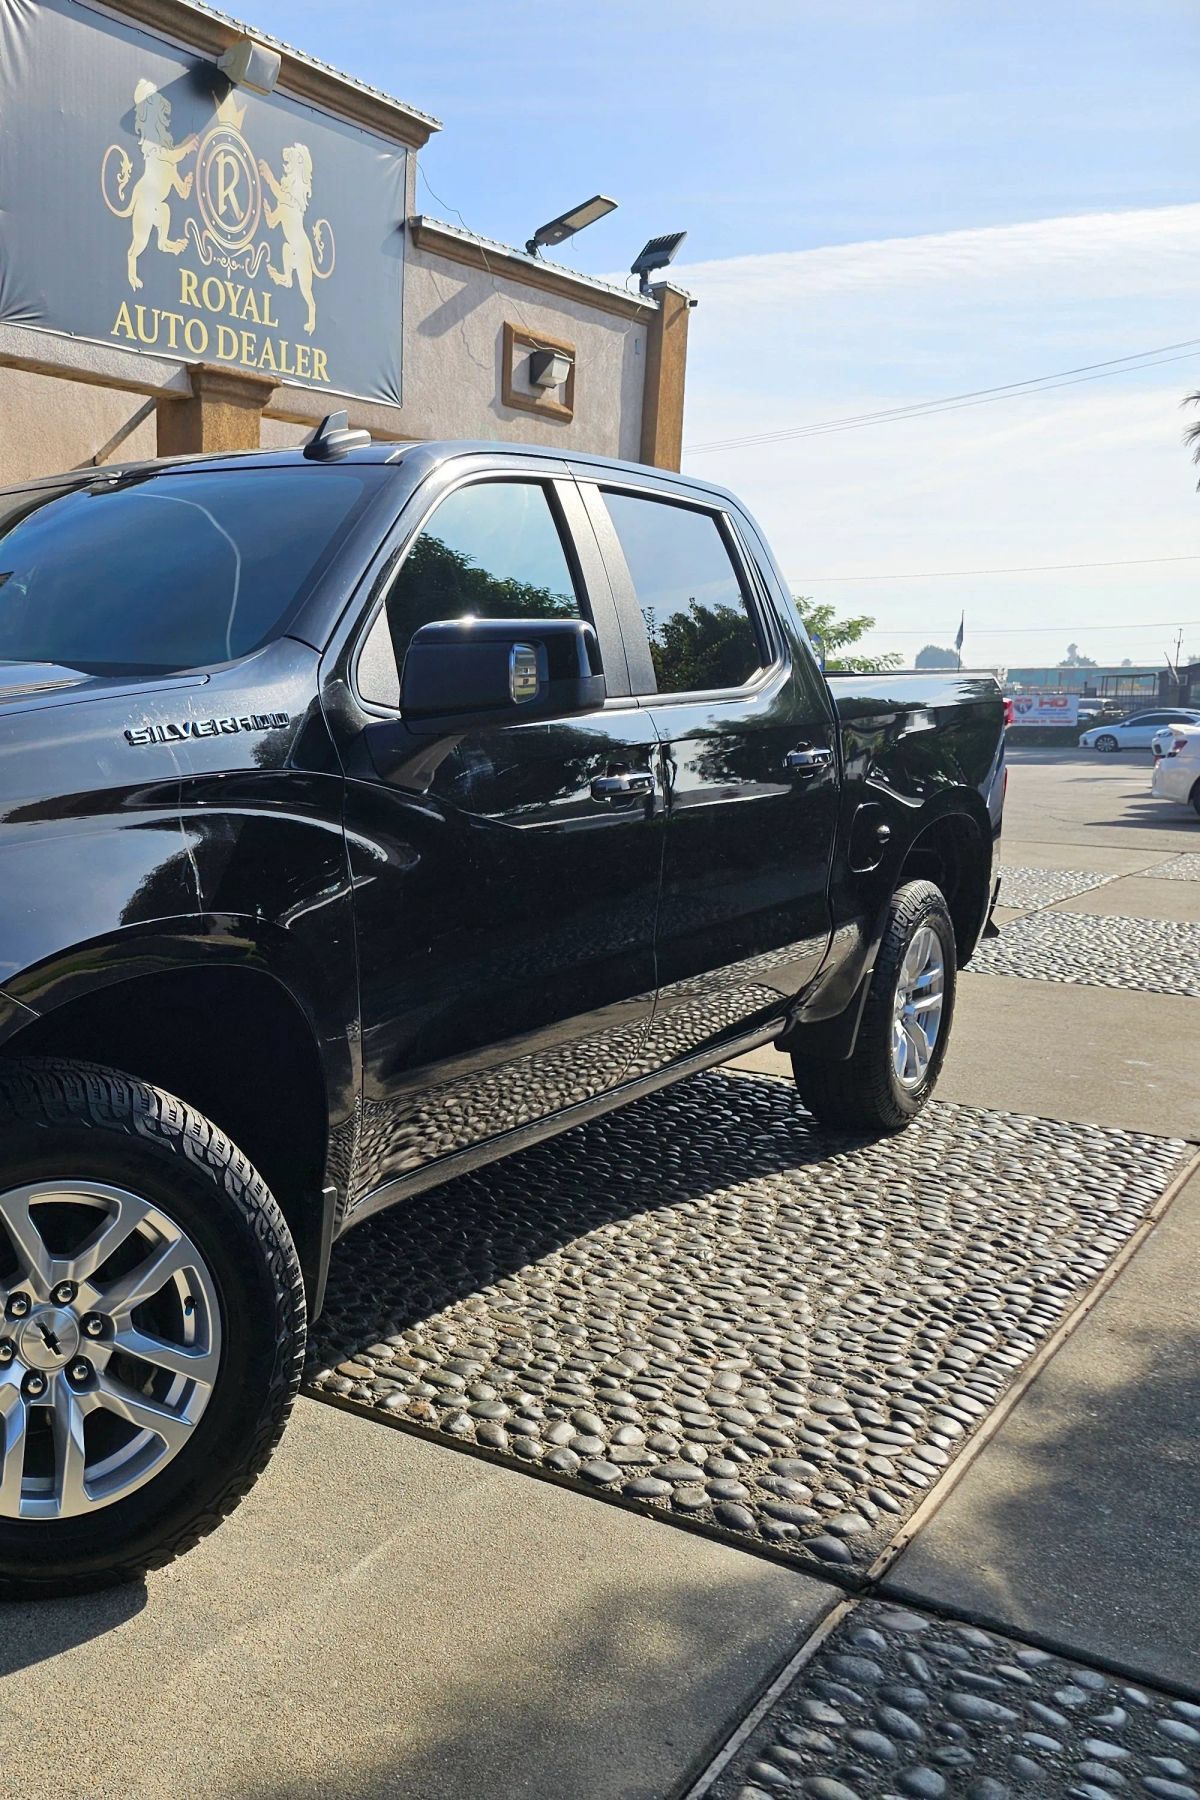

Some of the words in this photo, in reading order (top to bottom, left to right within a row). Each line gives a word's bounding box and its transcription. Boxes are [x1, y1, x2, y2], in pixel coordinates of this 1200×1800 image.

[215, 151, 245, 222] R
[179, 267, 280, 329] ROYAL
[110, 301, 209, 354] AUTO
[215, 324, 332, 383] DEALER
[123, 711, 290, 747] SILVERADO
